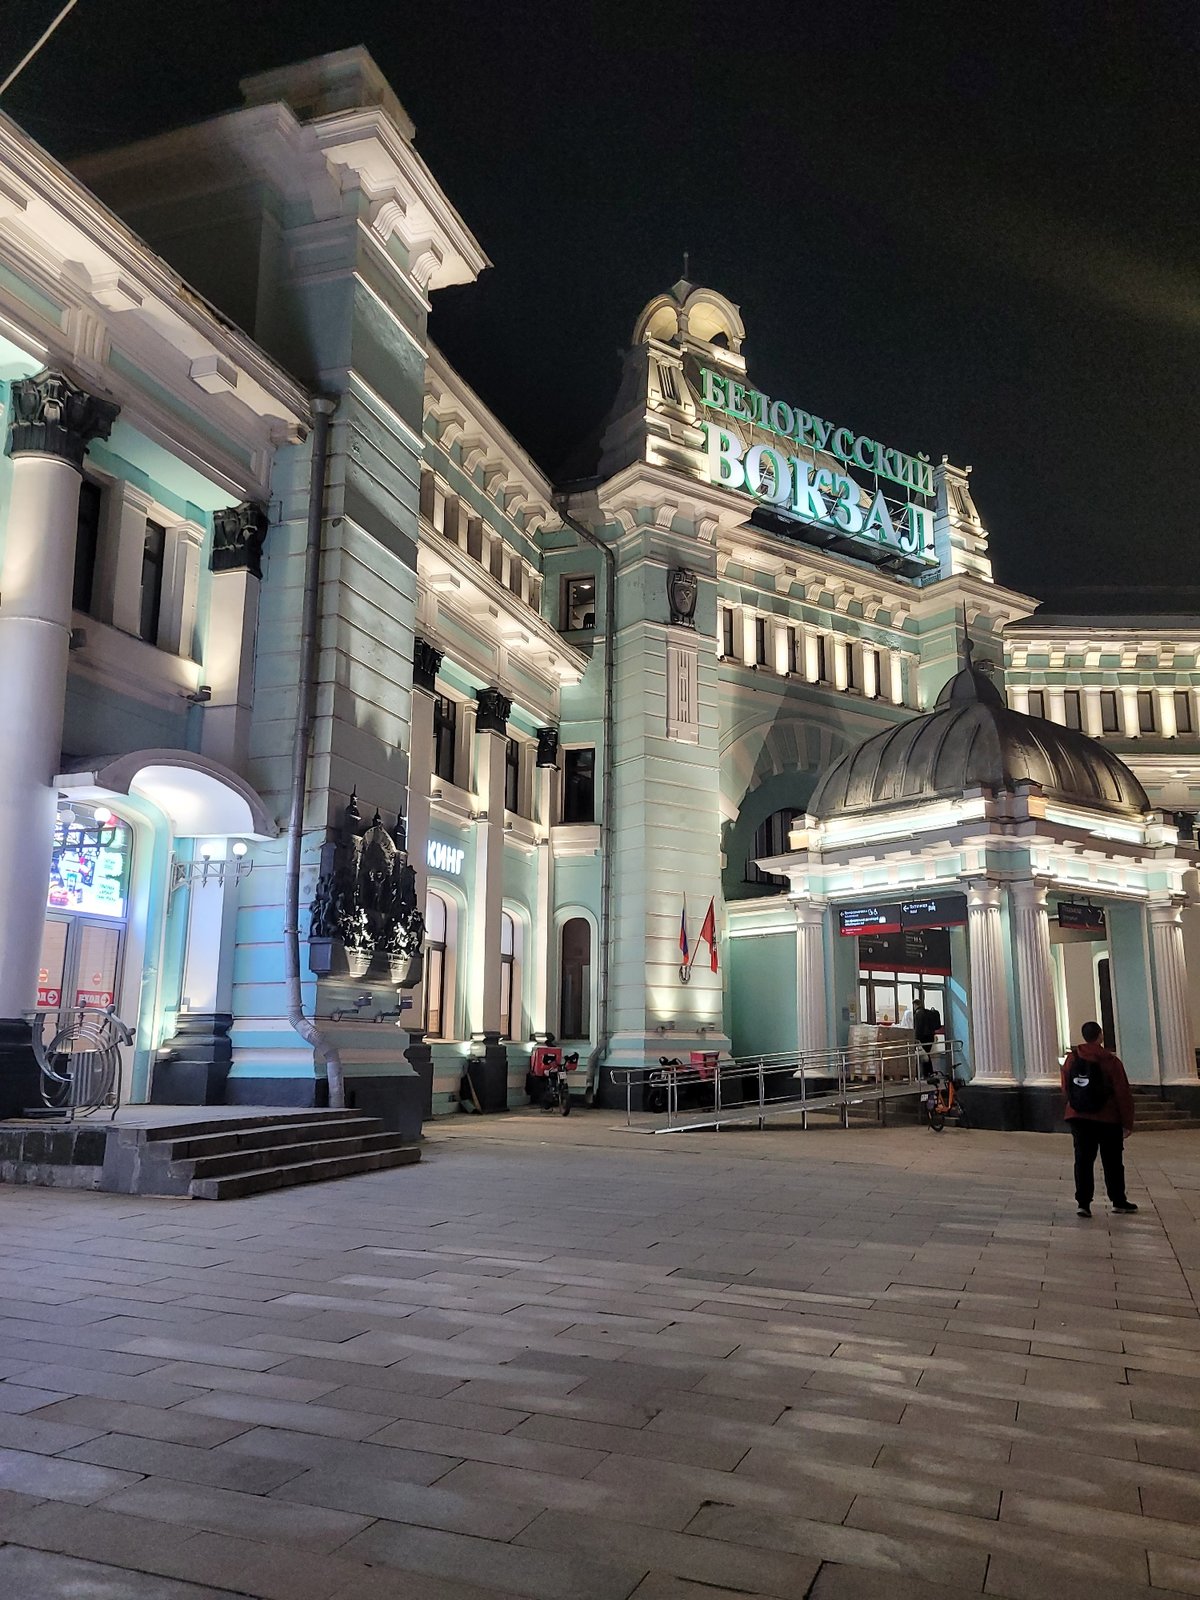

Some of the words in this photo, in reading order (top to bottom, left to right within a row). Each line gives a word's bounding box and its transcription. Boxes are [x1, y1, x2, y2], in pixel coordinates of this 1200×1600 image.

[700, 368, 936, 497] БЕЛОРУССКИЙ
[700, 421, 940, 565] ВОКЗАЛ
[427, 840, 465, 875] КИНГ
[1097, 909, 1104, 924] 2
